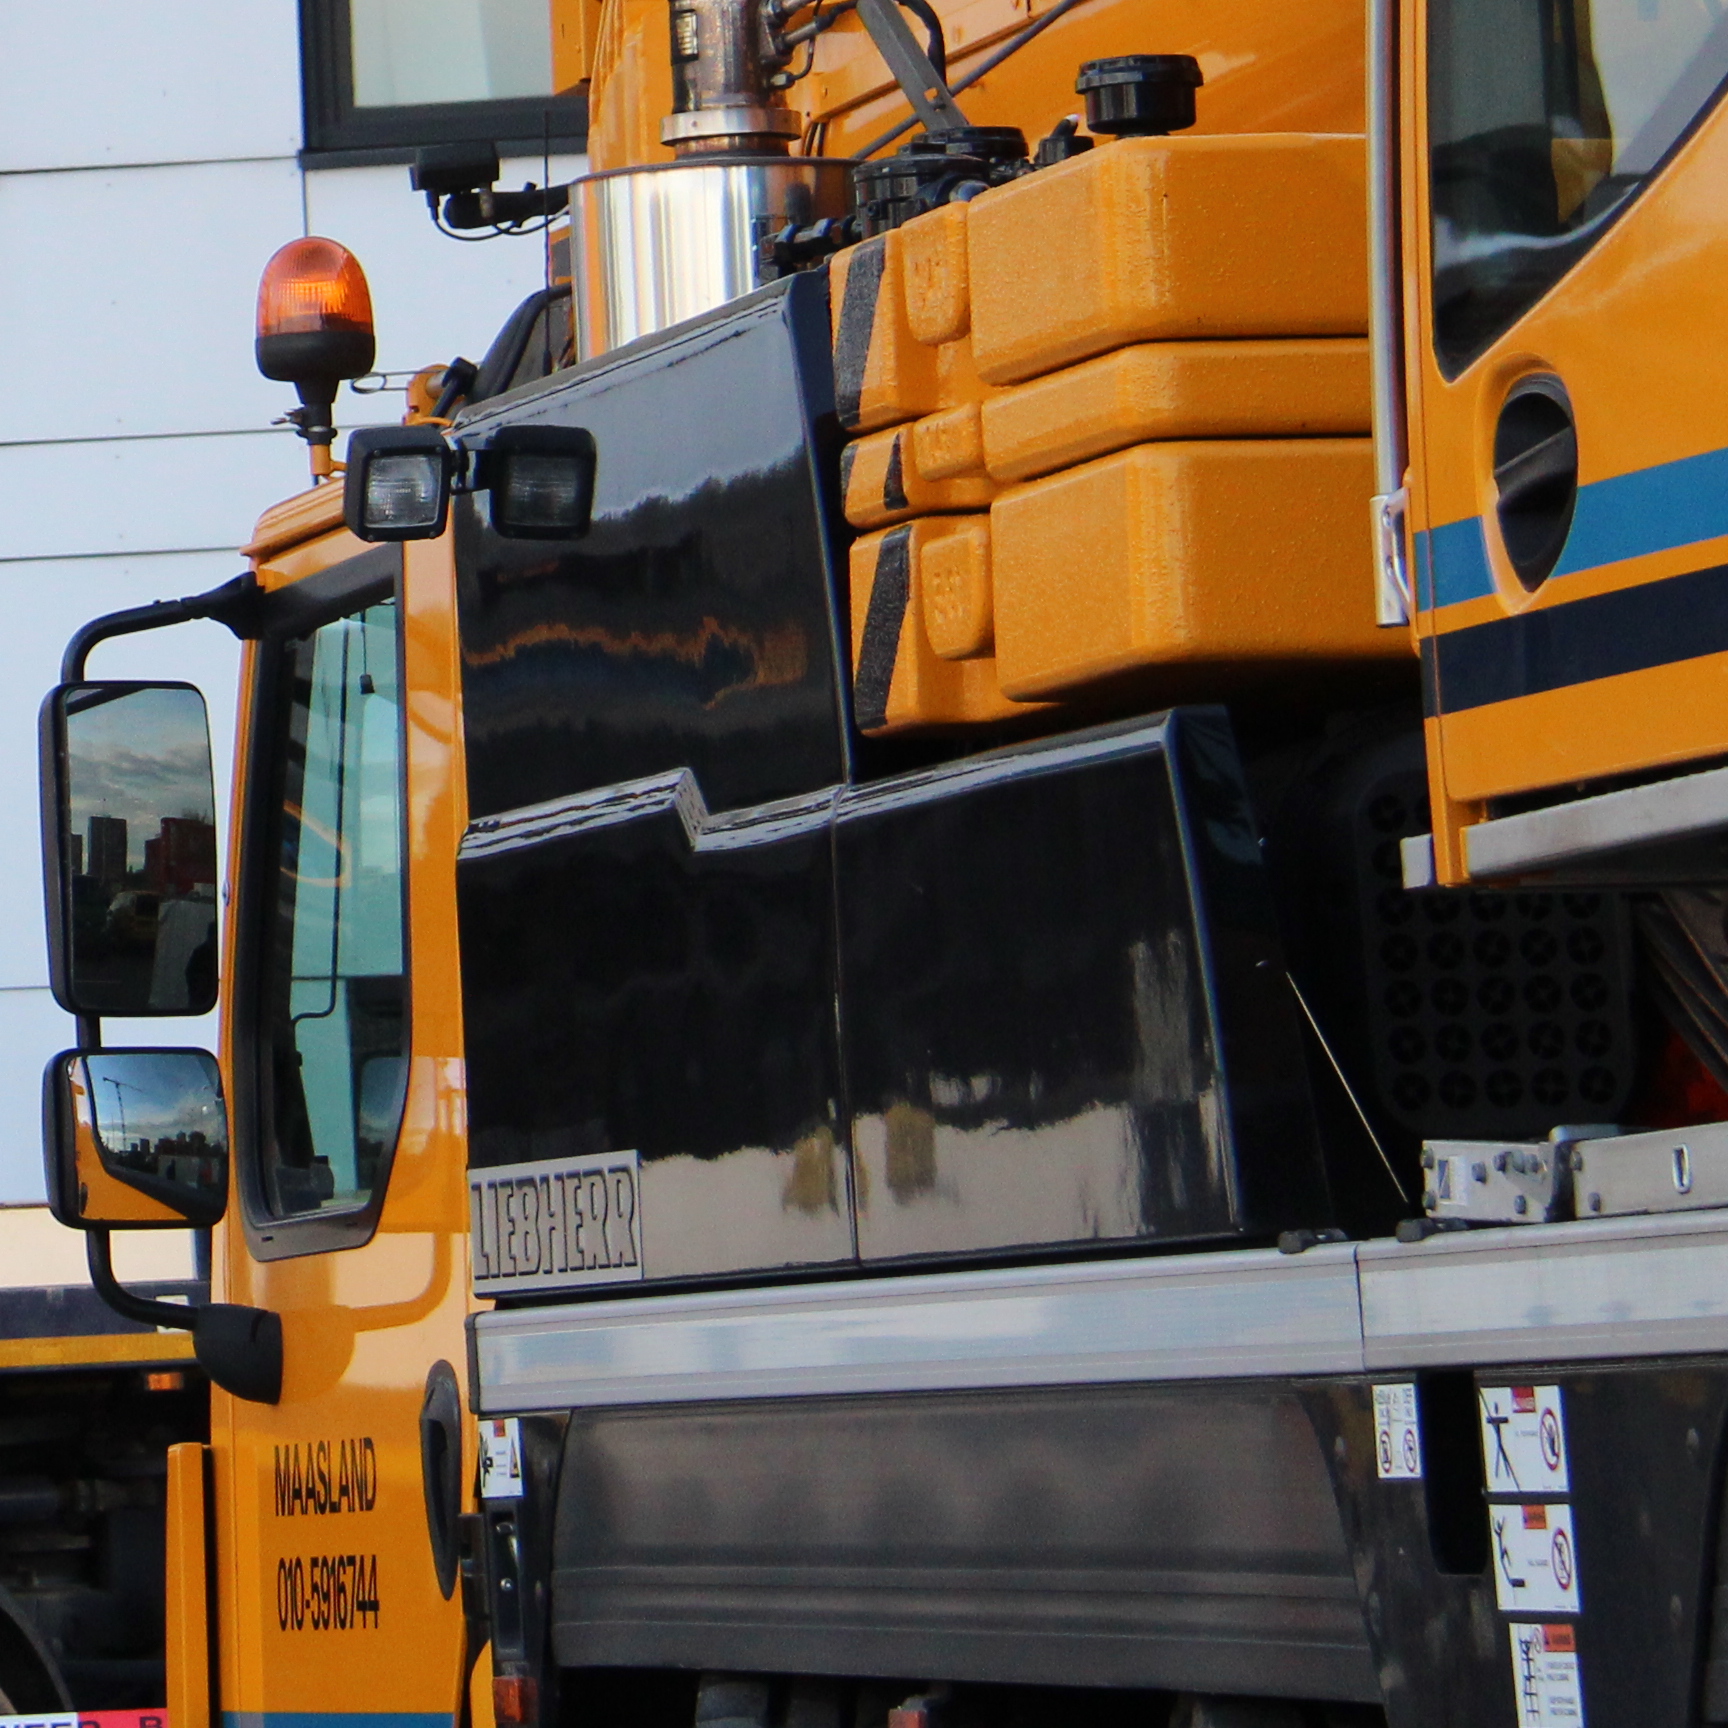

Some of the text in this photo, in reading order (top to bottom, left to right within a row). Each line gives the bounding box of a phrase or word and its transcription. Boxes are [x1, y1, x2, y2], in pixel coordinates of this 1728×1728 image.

[470, 1163, 639, 1281] LIEBHERR
[274, 1436, 377, 1517] MAASLAND
[277, 1554, 380, 1631] 010-5916744
